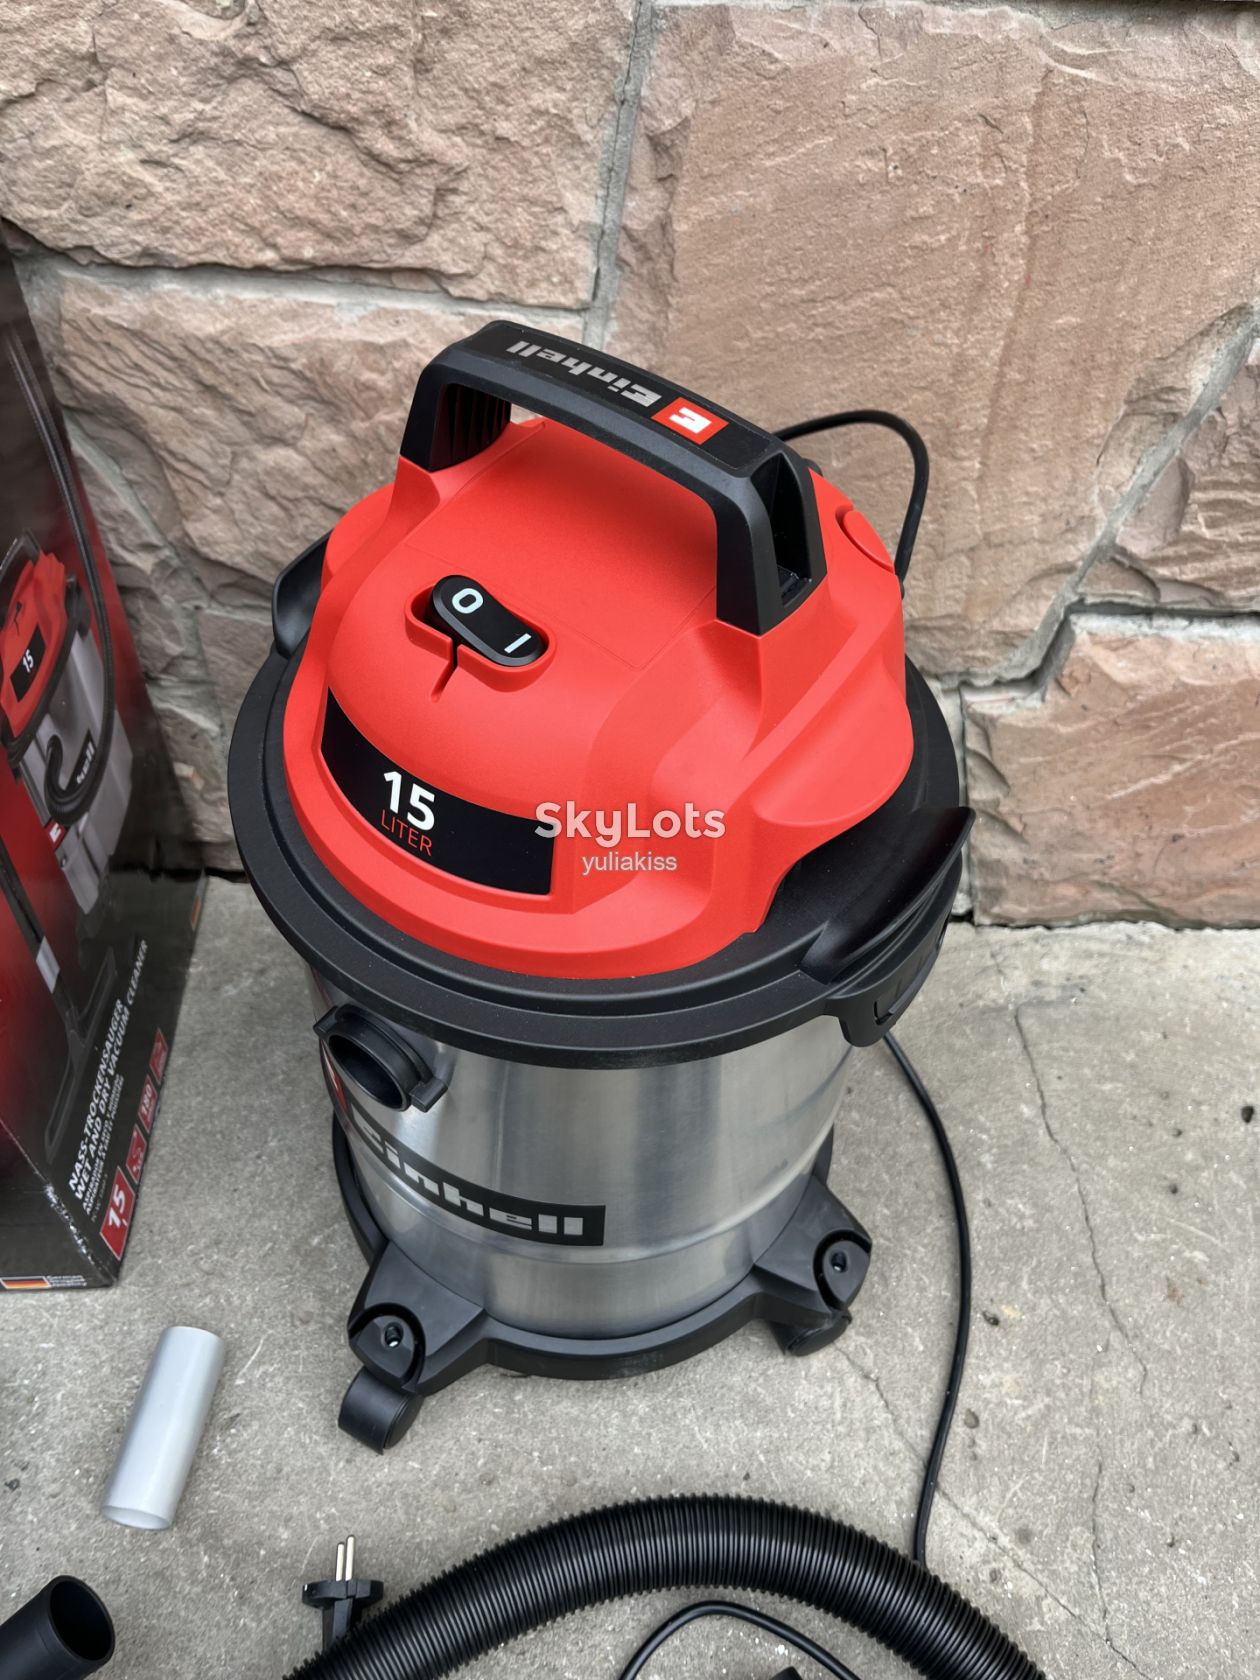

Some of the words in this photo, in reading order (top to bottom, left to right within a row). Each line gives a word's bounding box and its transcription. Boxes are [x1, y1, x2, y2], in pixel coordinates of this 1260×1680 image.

[506, 341, 662, 407] Einhell
[23, 649, 34, 672] 15
[384, 771, 435, 831] 15
[380, 809, 432, 857] LITER
[69, 999, 123, 1190] NASS-TROCKENSAUGER
[75, 1158, 91, 1199] WET
[89, 1117, 101, 1158] AND
[99, 1077, 110, 1114] DRY
[107, 1006, 129, 1075] VACUUM
[127, 940, 147, 1005] CLEANER
[109, 1184, 126, 1228] 15
